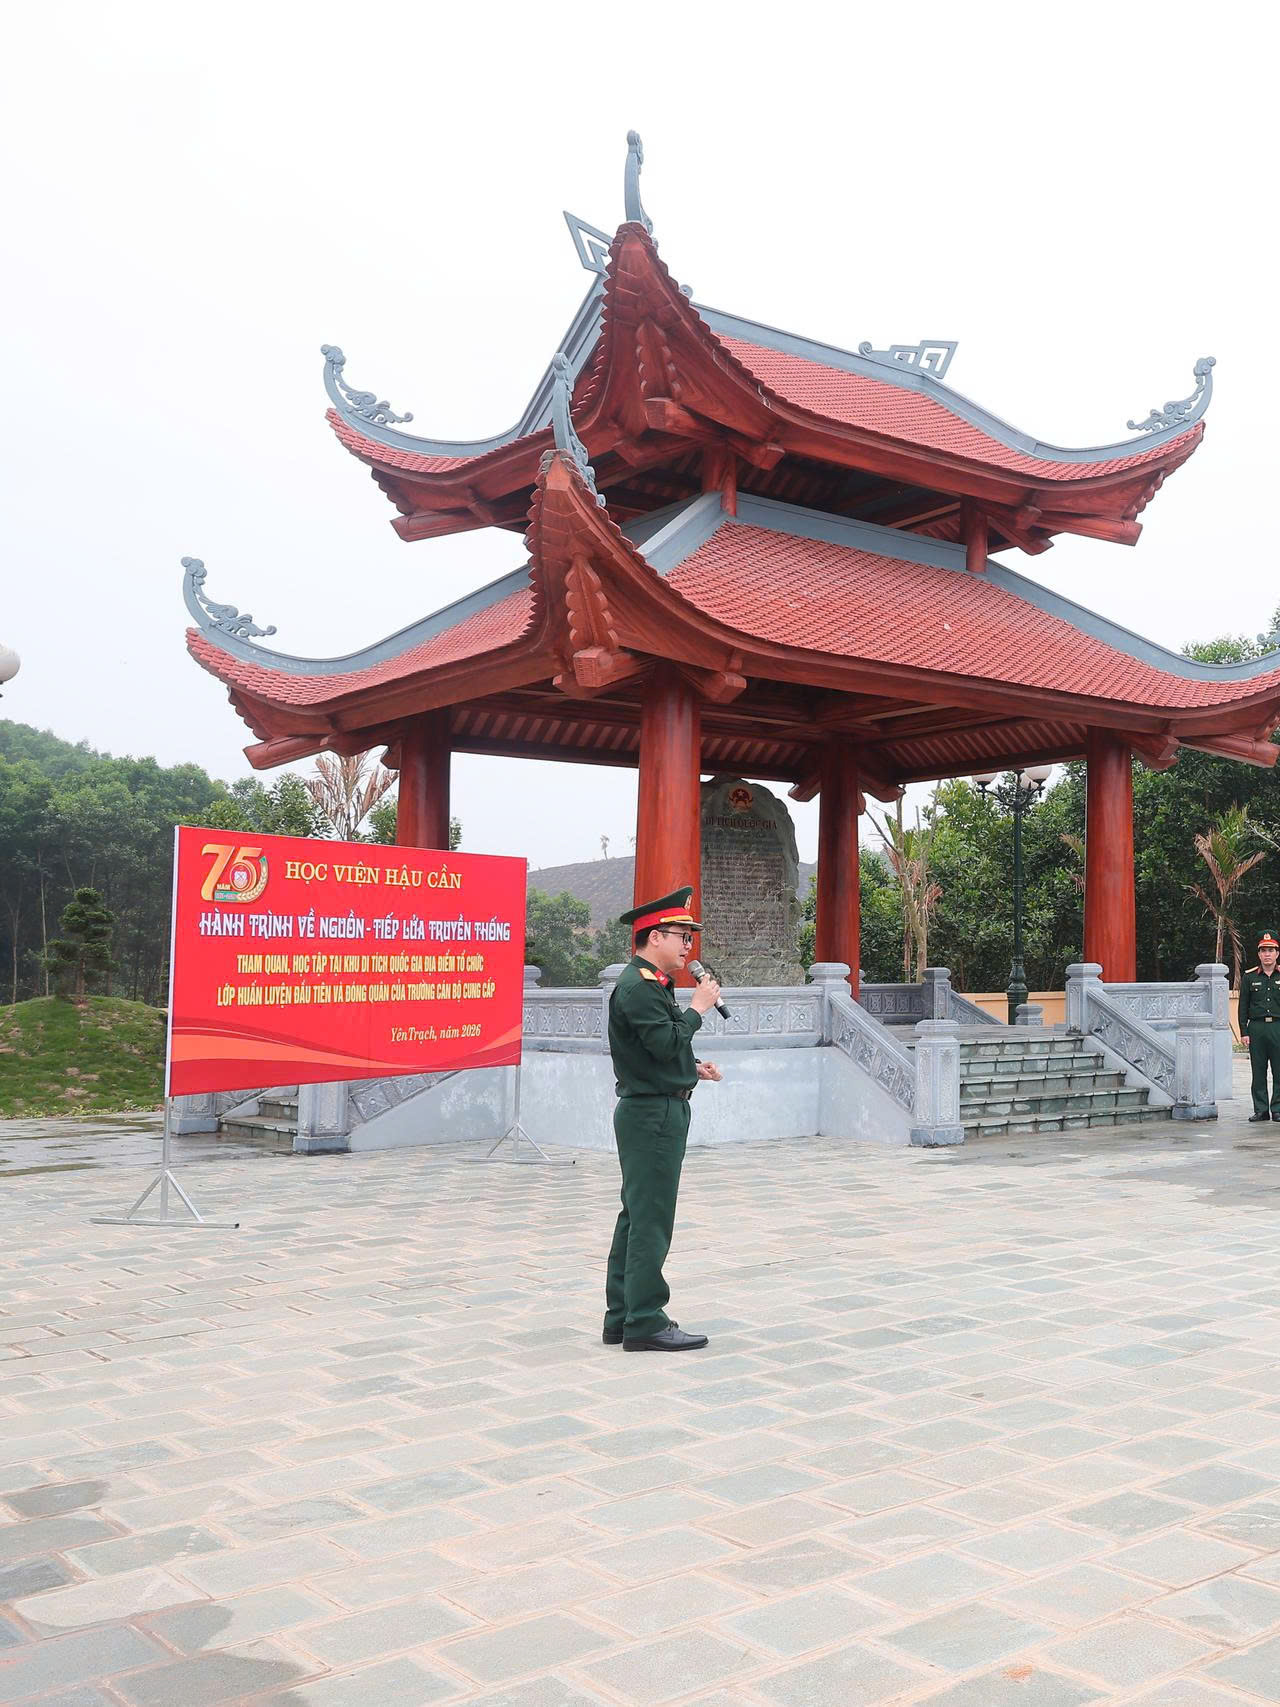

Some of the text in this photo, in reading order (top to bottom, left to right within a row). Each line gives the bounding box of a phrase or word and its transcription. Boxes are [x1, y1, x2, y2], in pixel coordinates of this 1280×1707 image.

[762, 819, 778, 831] GIA
[201, 844, 264, 902] 75
[285, 861, 462, 890] HỌC VIỆN HẬU CẦN
[199, 908, 244, 936] HÀNH
[249, 910, 293, 939] TRÌNH
[298, 907, 315, 938] VỀ
[319, 909, 365, 939] NGUỒN
[373, 912, 399, 940] TIẾP
[403, 914, 425, 940] LỬA
[429, 914, 471, 942] TRUYỀN
[475, 916, 511, 942] THỐNG
[237, 954, 263, 974] THAM
[264, 954, 291, 976] QUAN,
[293, 955, 310, 977] HỌC
[312, 951, 328, 977] TẬP
[329, 955, 342, 977] TẠI
[343, 955, 360, 973] KHU
[361, 955, 370, 973] DI
[371, 951, 388, 973] TÍCH
[390, 950, 410, 975] QUỐC
[411, 955, 422, 973] GIA
[424, 955, 436, 976] ĐỊA
[466, 952, 484, 972] CHỨC
[217, 982, 236, 1006] LỚP
[237, 979, 263, 1006] HUẤN
[264, 982, 292, 1008] LUYỆN
[312, 982, 331, 1004] TIÊN
[333, 982, 344, 1003] VÀ
[345, 981, 367, 1002] ĐÓNG
[368, 981, 390, 1004] QUÂN
[391, 978, 406, 1002] CỦA
[408, 979, 436, 1001] TRƯỜNG
[436, 979, 451, 1000] CÁN
[452, 979, 462, 1003] BỘ
[463, 983, 481, 999] CUNG
[482, 976, 496, 999] CẤP
[391, 1027, 408, 1042] Yên
[440, 1025, 460, 1039] năm
[461, 1024, 482, 1038] 2026
